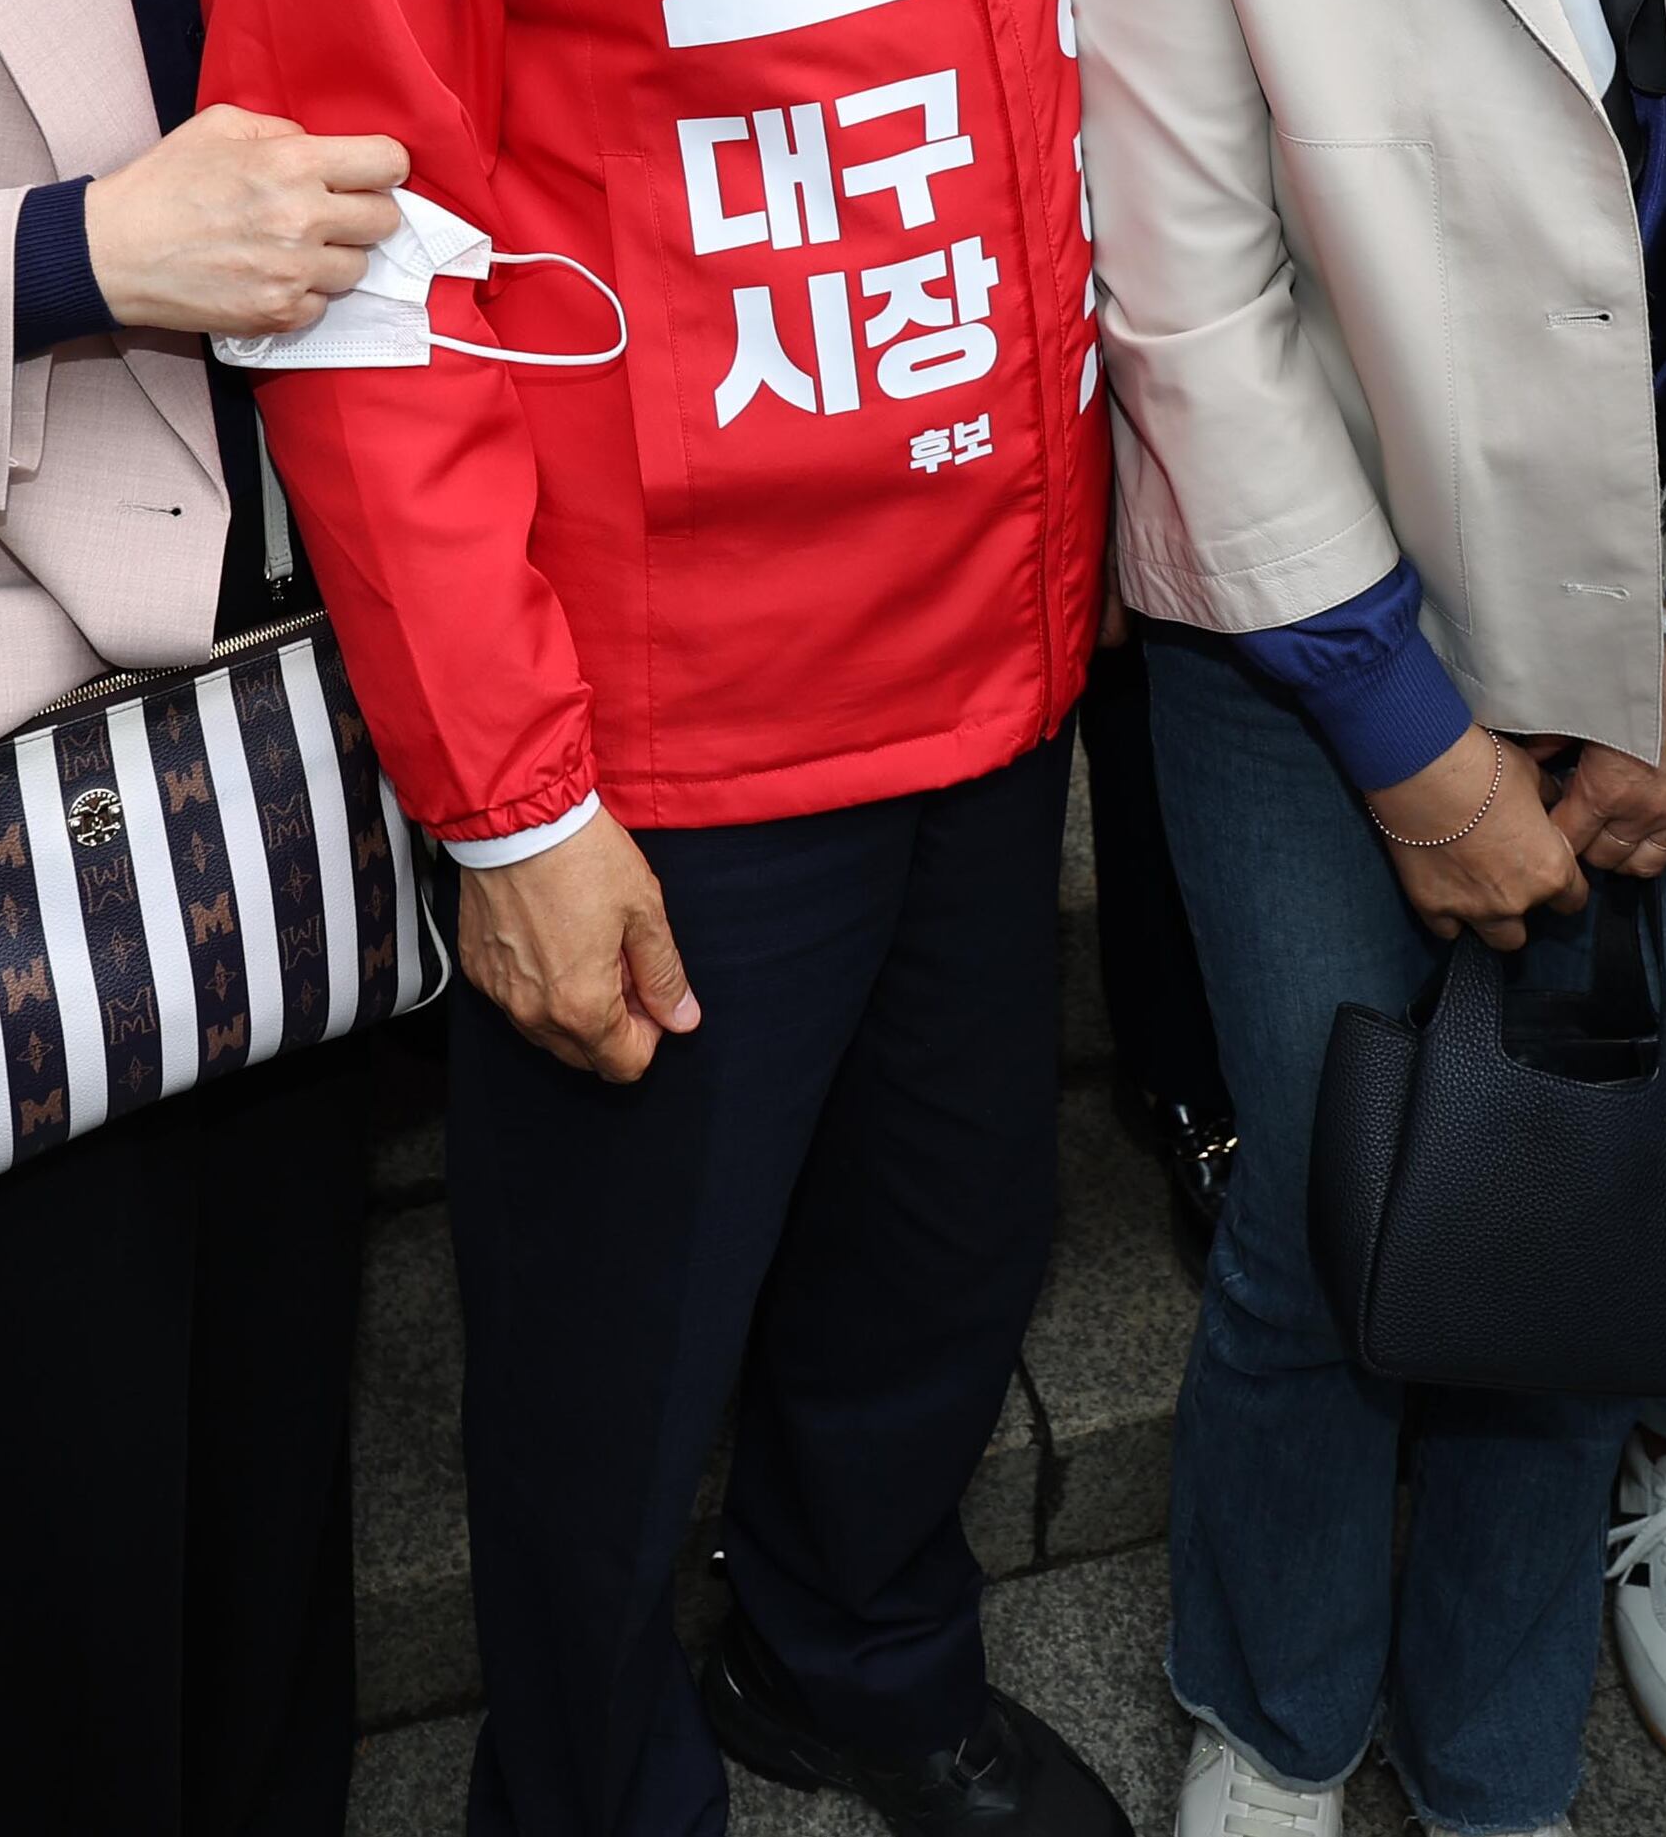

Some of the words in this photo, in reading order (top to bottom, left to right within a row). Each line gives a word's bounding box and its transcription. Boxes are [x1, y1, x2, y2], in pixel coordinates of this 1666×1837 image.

[677, 70, 975, 256] 대구
[714, 237, 1000, 429] 시장
[910, 413, 993, 474] 후보
